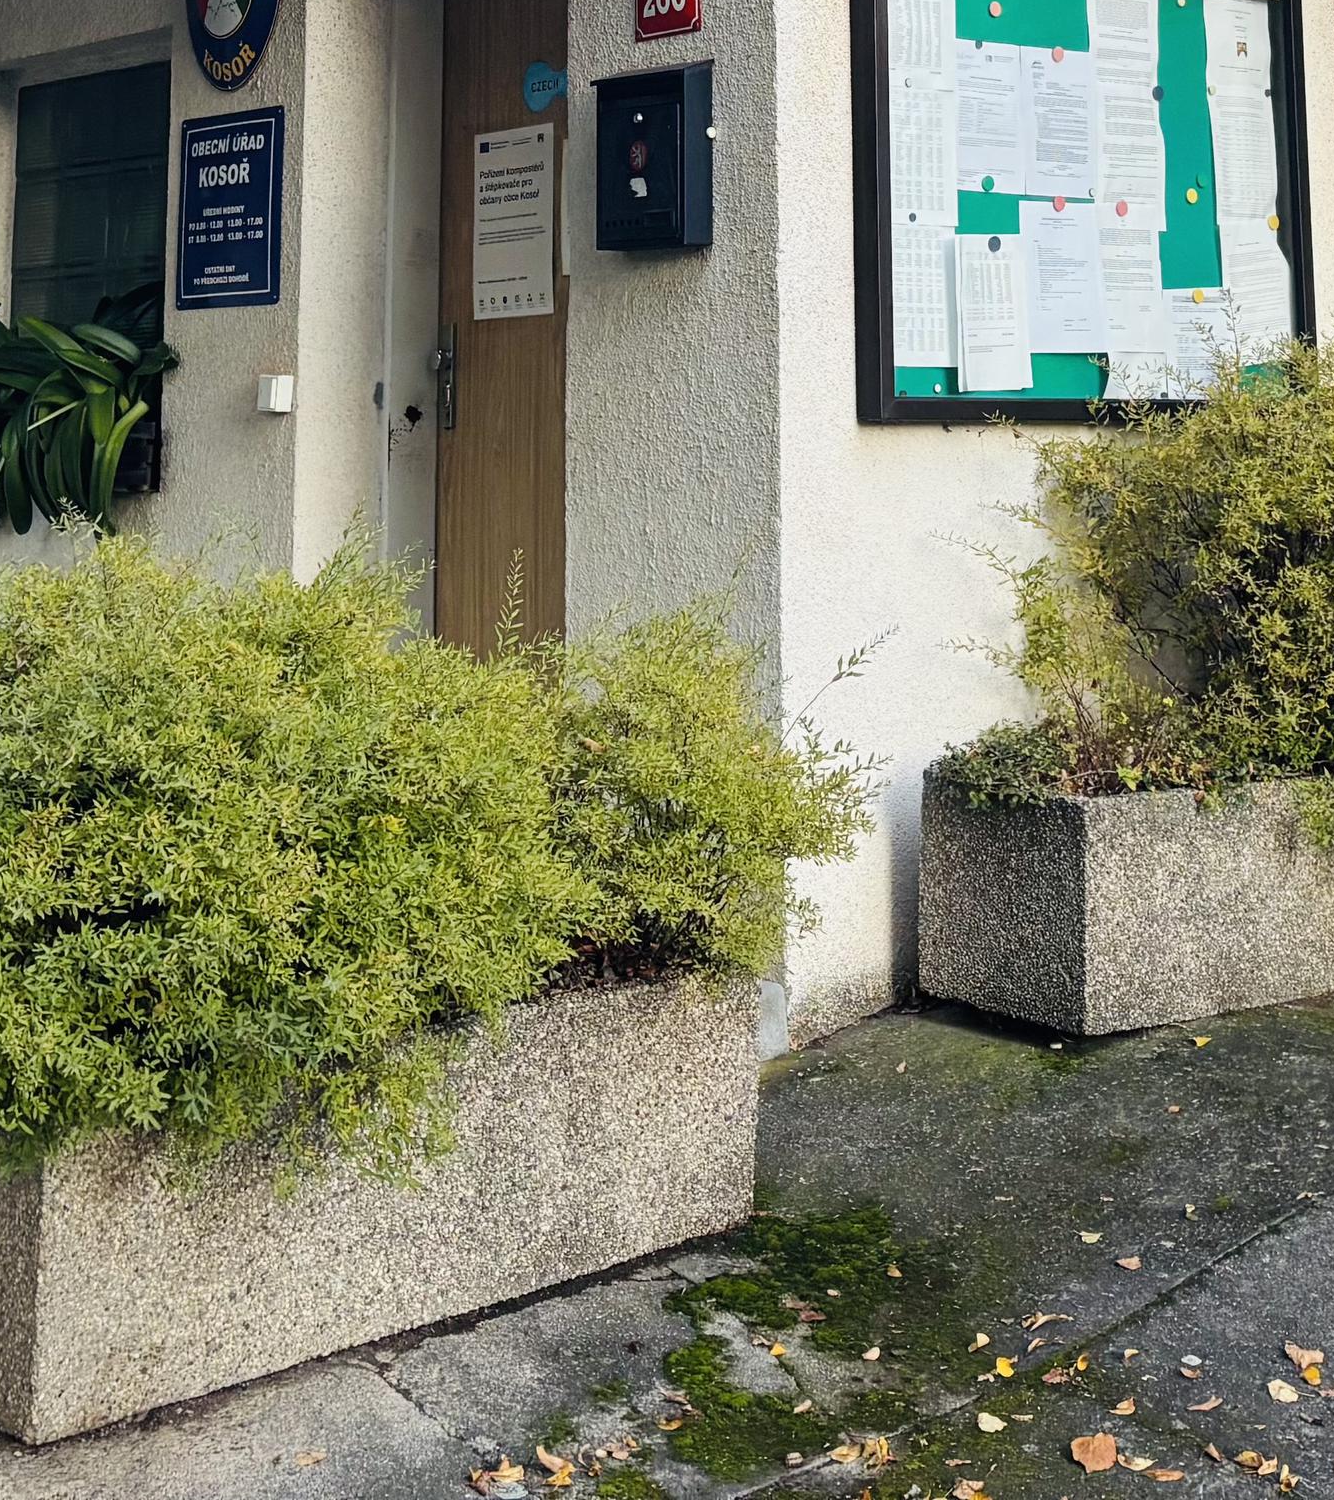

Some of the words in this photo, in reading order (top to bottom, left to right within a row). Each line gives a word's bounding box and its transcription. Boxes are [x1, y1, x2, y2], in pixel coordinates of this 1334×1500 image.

[203, 40, 256, 82] KOSOŘ
[192, 134, 230, 157] OBECNÍ
[233, 132, 264, 151] ÚŘAD
[198, 157, 250, 188] KOSOŘ
[247, 217, 263, 226] 17.00
[247, 230, 263, 239] 17.00
